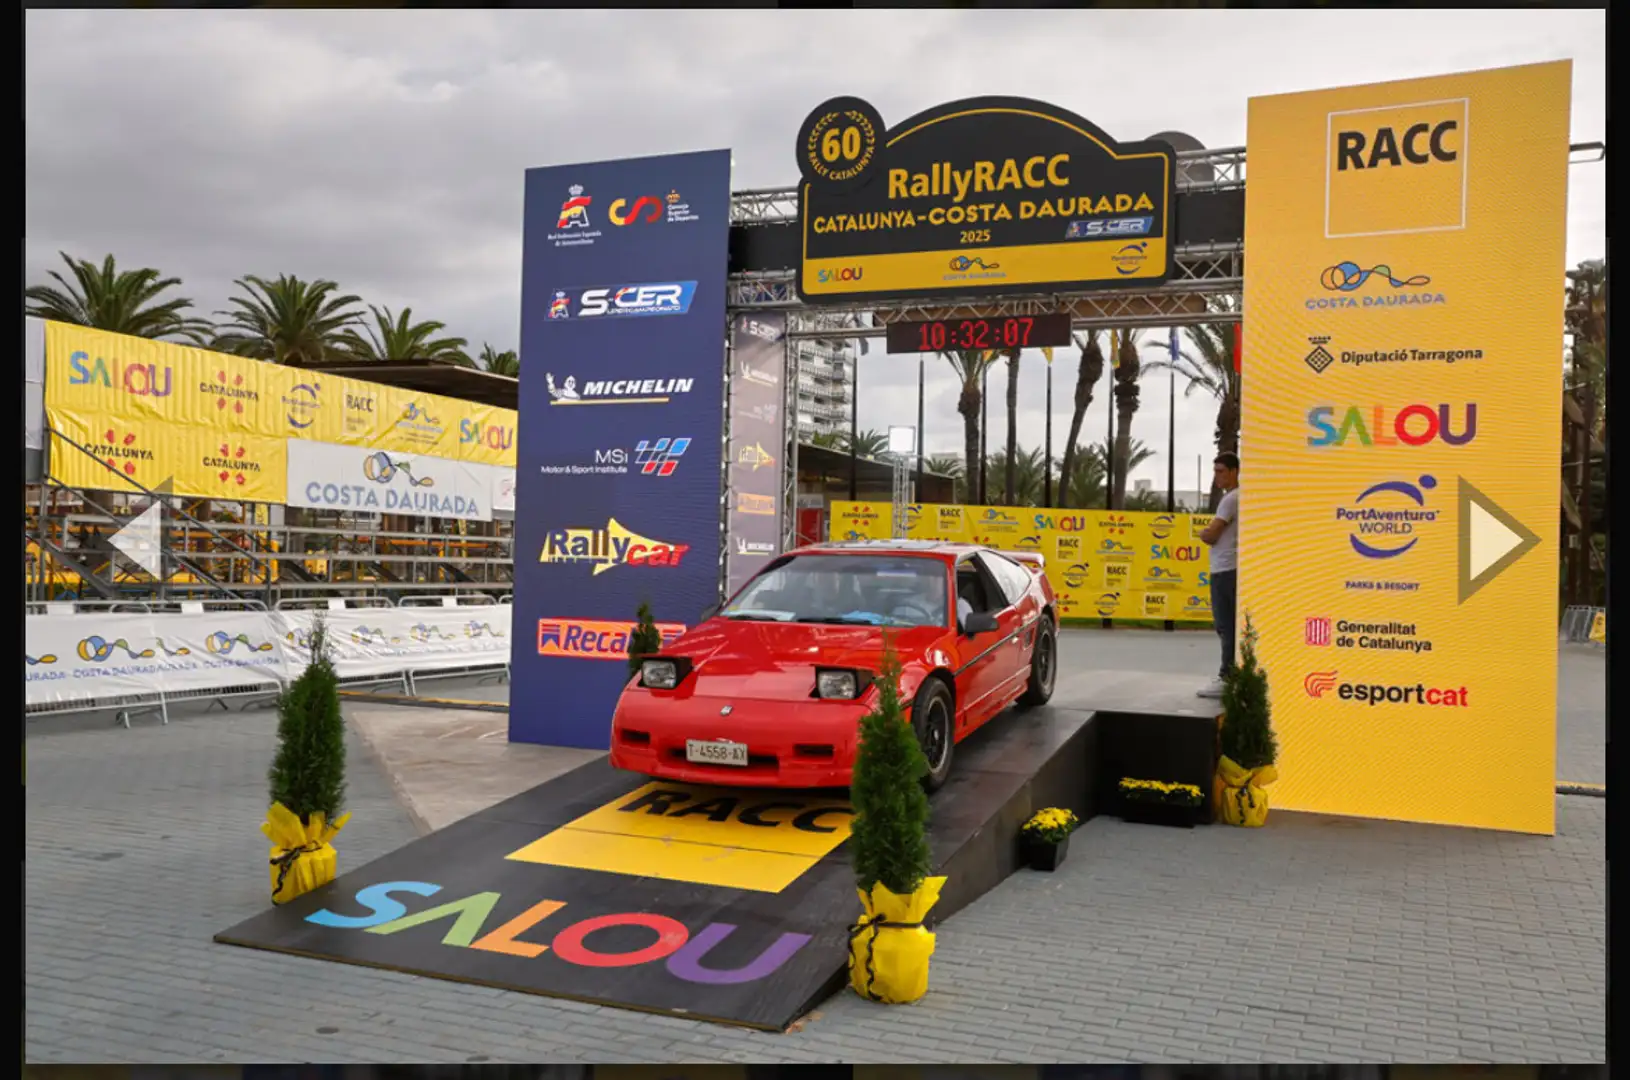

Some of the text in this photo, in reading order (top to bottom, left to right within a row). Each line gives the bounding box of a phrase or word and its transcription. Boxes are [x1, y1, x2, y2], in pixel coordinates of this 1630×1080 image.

[822, 126, 861, 162] 60
[1337, 120, 1457, 171] RACC
[887, 153, 1071, 202] RallyRACC
[1019, 192, 1155, 220] DAURADA
[960, 230, 991, 243] 2025
[817, 267, 863, 283] SALOU
[1305, 292, 1446, 311] COSTA DAURADA
[919, 318, 1034, 350] 10:32:07
[1341, 349, 1483, 366] Diputació Tarragona
[69, 350, 172, 396] SALOU
[199, 382, 259, 401] CATALUNYA
[583, 378, 694, 395] MICHELIN
[1307, 403, 1477, 446] SALOU
[84, 443, 154, 460] CATALUNYA
[202, 457, 260, 472] CATALUNYA
[305, 482, 479, 516] COSTA DAURADA
[1034, 514, 1085, 532] SALOU
[1336, 508, 1436, 521] PortAventura
[1359, 522, 1413, 534] WORLD
[1151, 544, 1200, 561] SALOU
[1345, 581, 1374, 590] PARKS
[1336, 620, 1416, 635] Generalitat
[1336, 636, 1433, 653] de Catalunya
[1338, 683, 1469, 707] esportcat
[618, 789, 856, 833] RACC
[303, 881, 813, 984] SALOU
